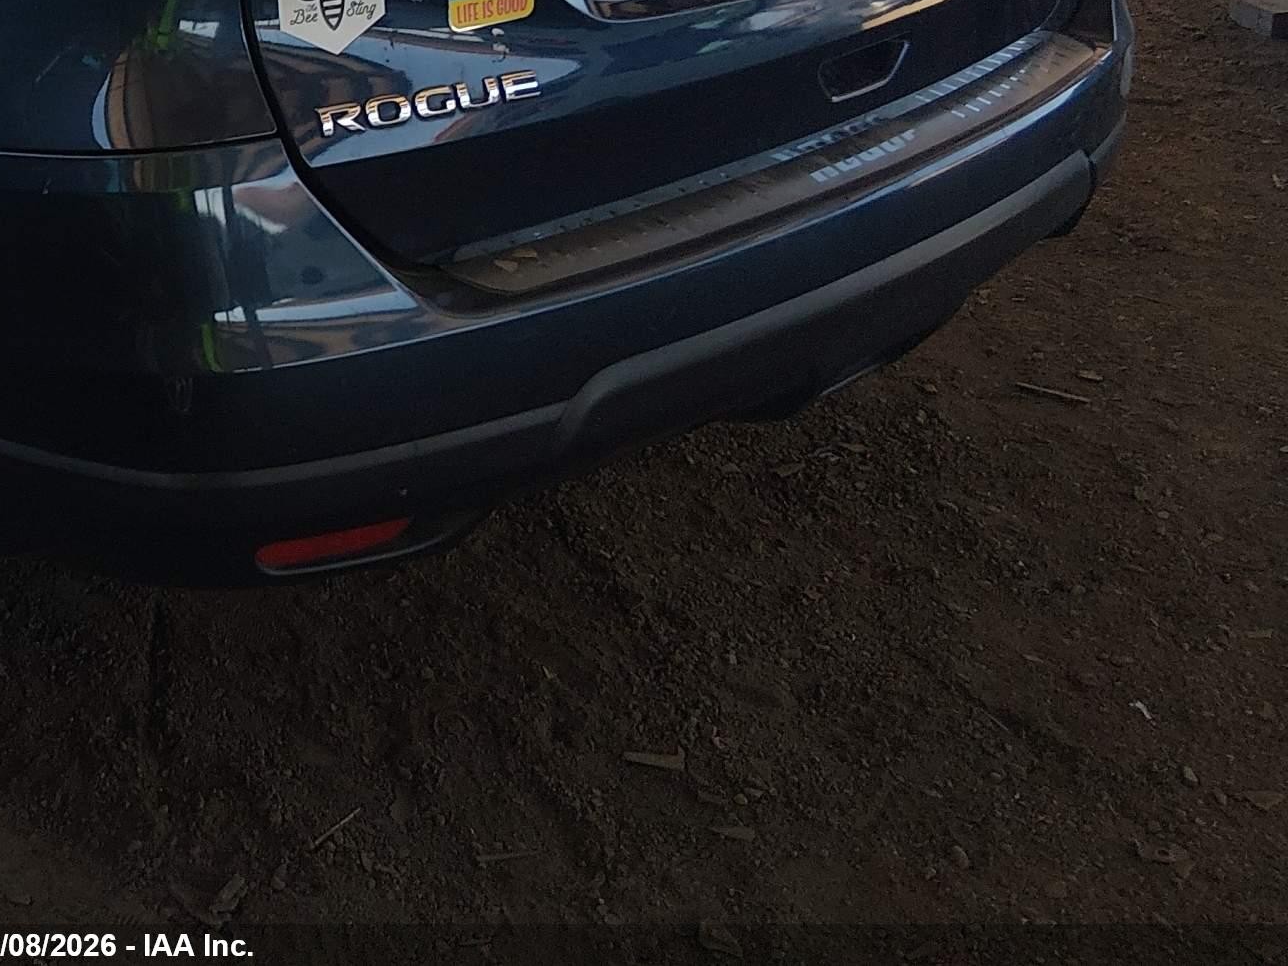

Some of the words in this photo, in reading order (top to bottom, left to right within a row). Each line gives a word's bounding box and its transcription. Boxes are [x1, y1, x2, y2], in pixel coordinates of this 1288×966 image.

[289, 8, 319, 26] Bee
[346, 0, 377, 20] Sting
[456, 3, 480, 24] LIFE
[481, 1, 494, 19] IS
[314, 69, 542, 137] ROGUE
